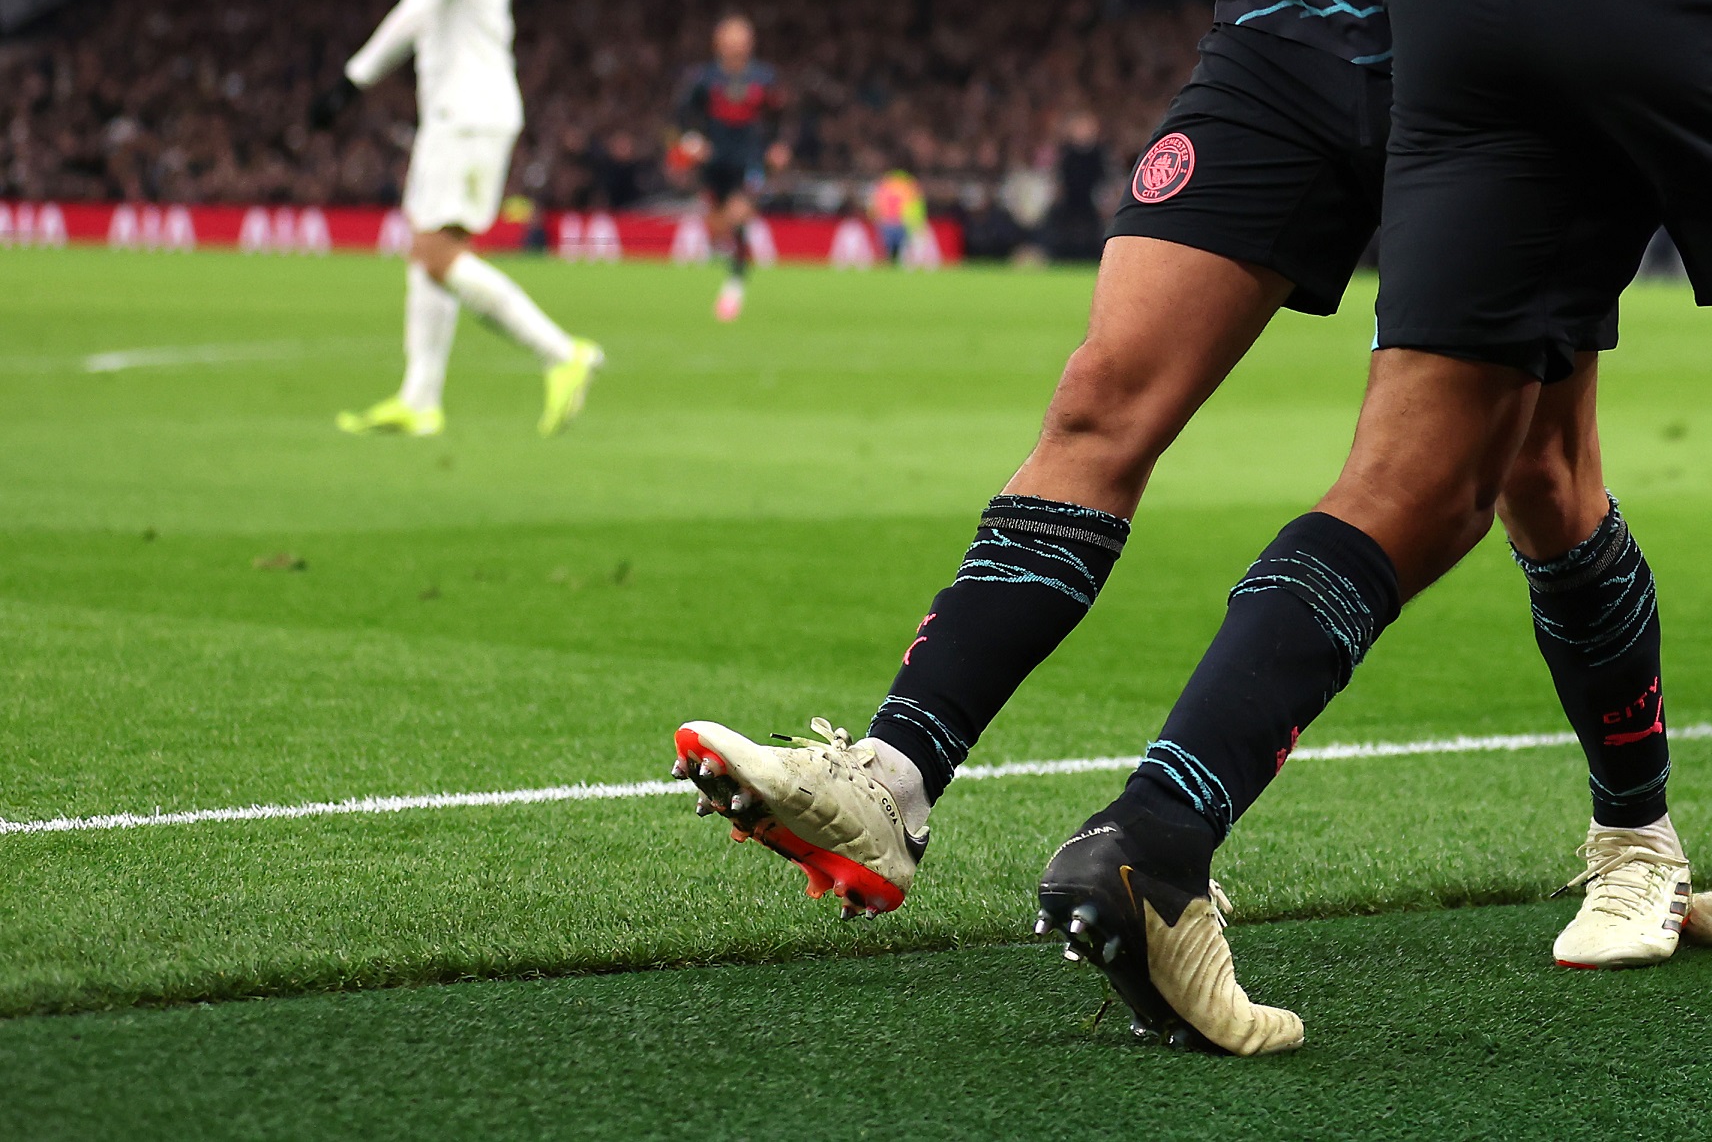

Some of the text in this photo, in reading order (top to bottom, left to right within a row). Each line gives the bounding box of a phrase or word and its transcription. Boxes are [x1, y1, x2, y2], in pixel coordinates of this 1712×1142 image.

[1147, 138, 1189, 162] MANCHESTER
[1141, 189, 1161, 198] CITY
[1603, 675, 1659, 725] CITY
[881, 797, 899, 825] COPA
[1080, 825, 1118, 839] LUNA
